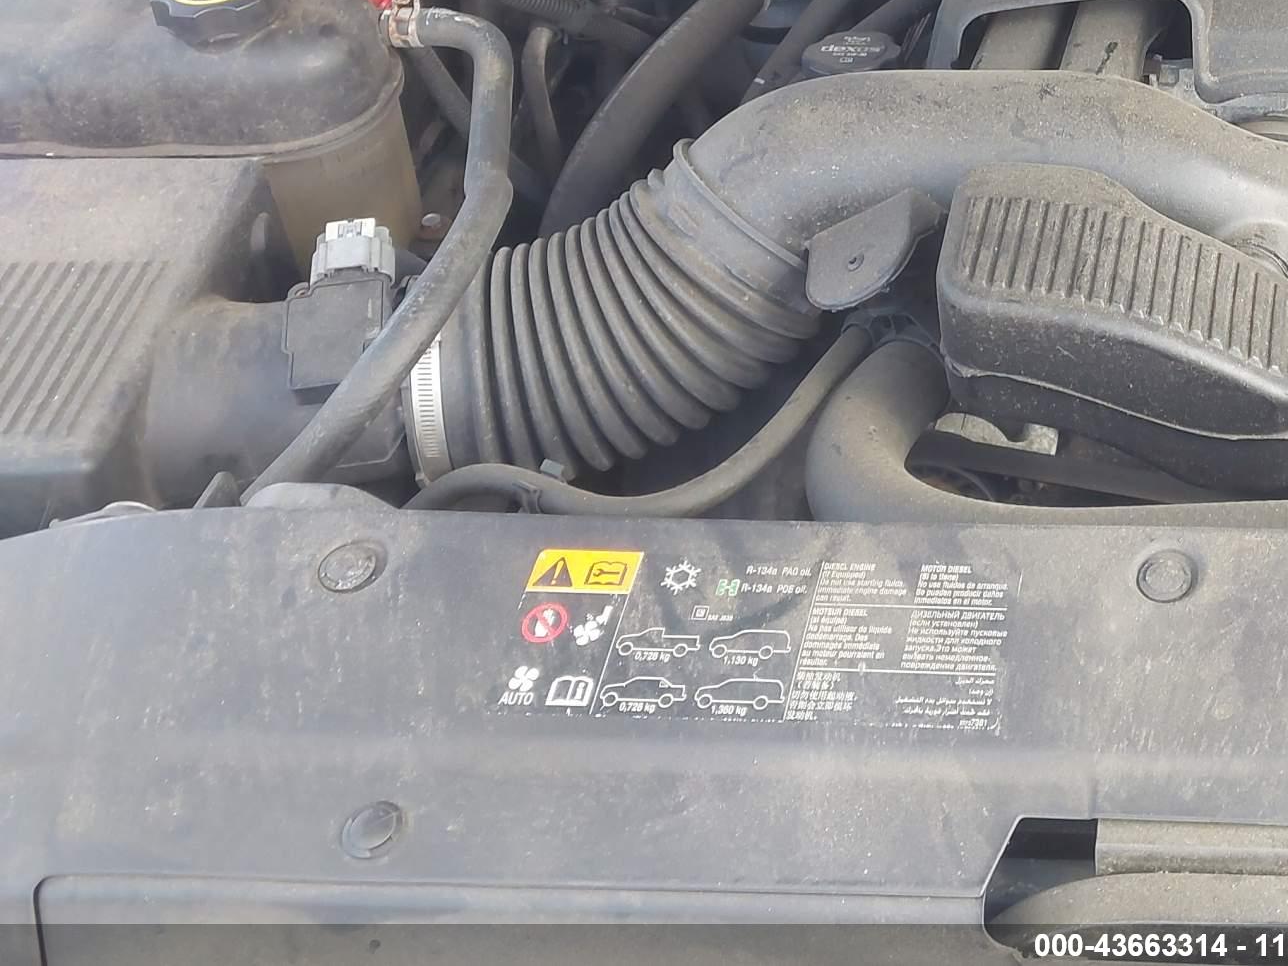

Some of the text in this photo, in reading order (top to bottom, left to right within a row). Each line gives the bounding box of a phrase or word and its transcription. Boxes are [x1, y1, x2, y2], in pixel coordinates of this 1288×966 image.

[746, 566, 778, 576] R-134a
[800, 566, 812, 576] oil.
[947, 564, 972, 574] DIESEL
[740, 583, 773, 594] R-134a
[794, 584, 808, 594] oil.
[659, 652, 670, 662] kg
[747, 656, 758, 666] kg
[498, 691, 534, 706] AUTO
[644, 702, 656, 714] kg
[735, 706, 747, 716] kg
